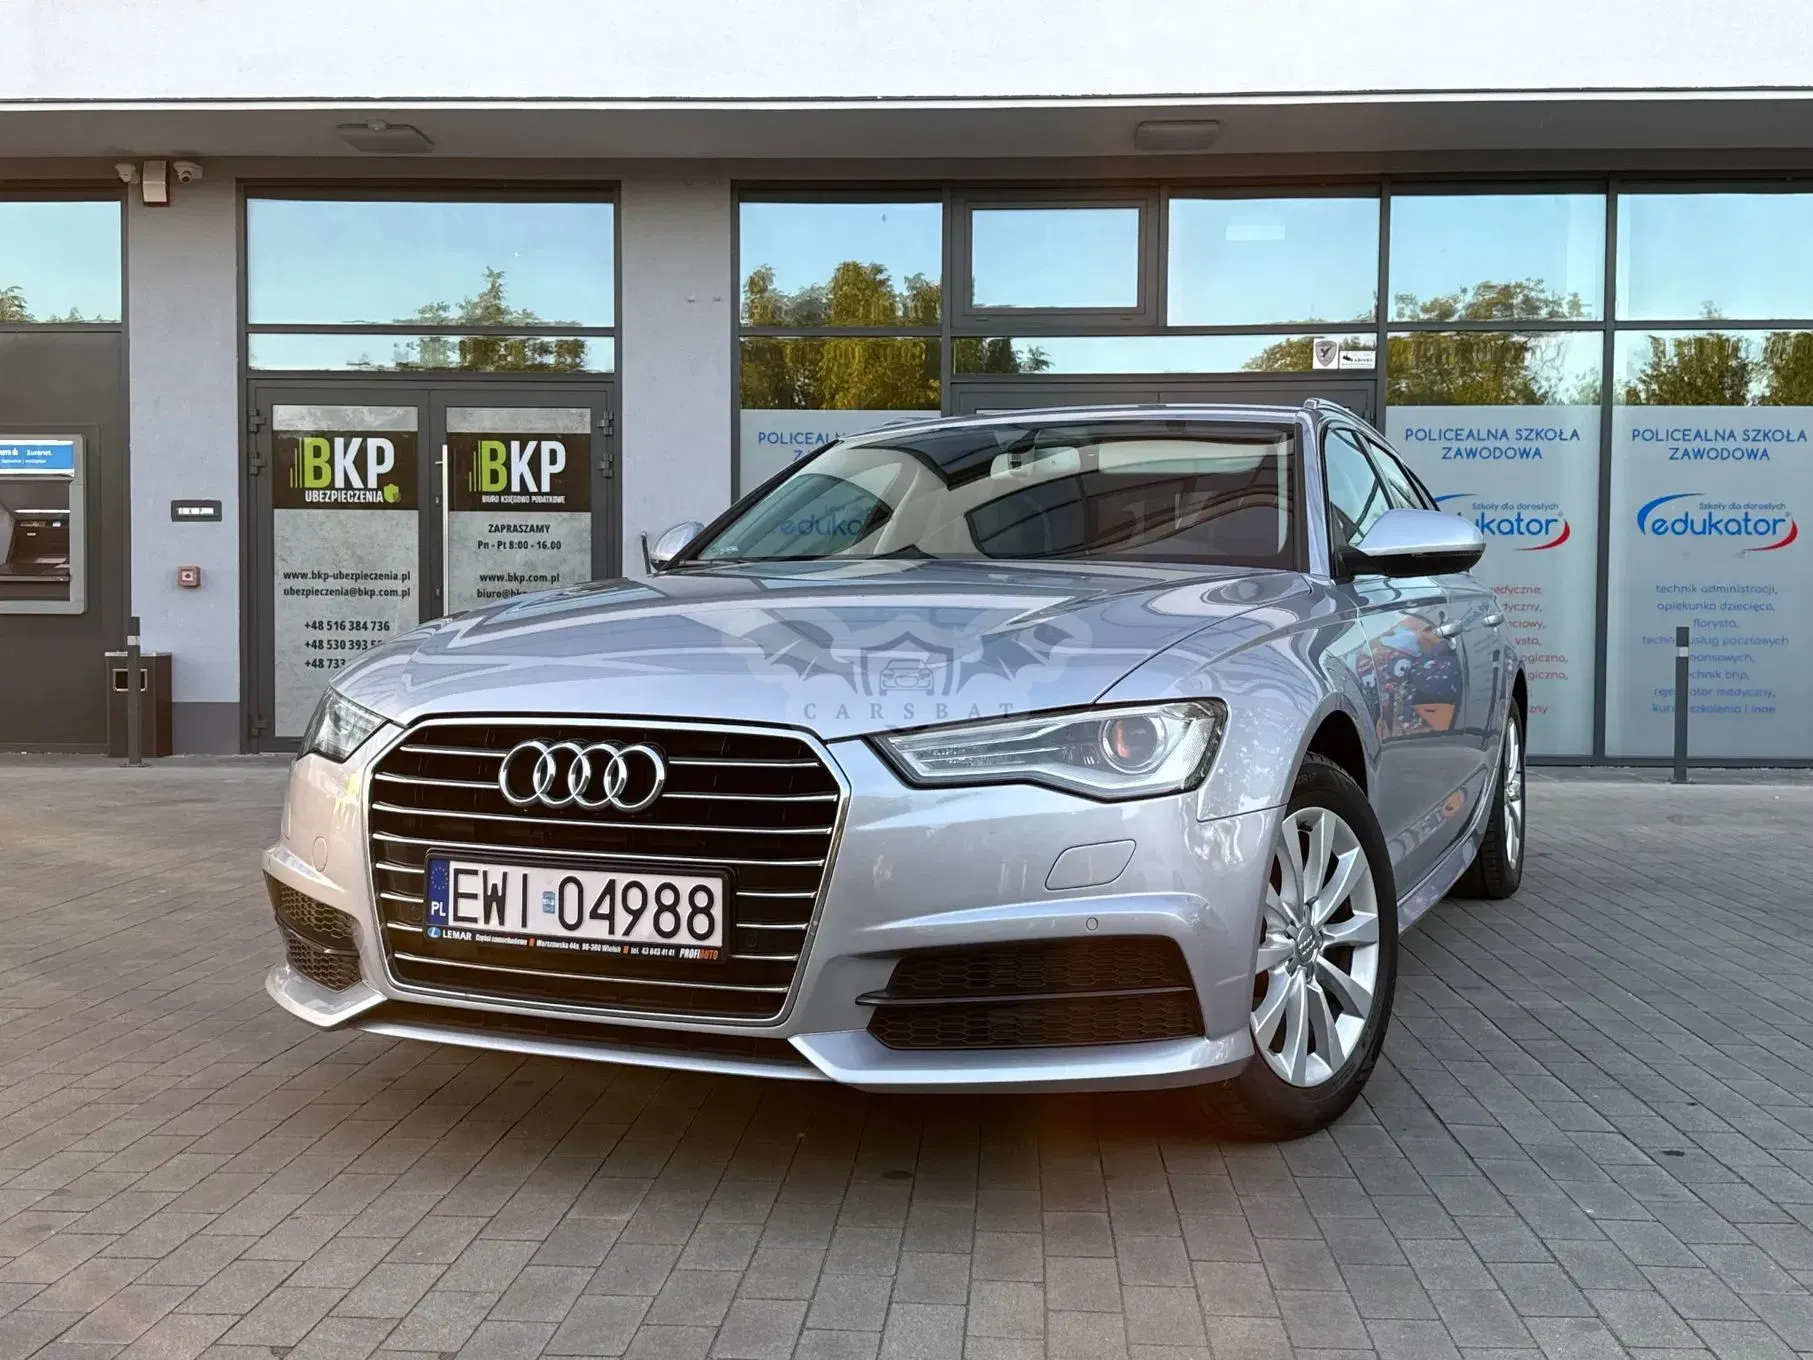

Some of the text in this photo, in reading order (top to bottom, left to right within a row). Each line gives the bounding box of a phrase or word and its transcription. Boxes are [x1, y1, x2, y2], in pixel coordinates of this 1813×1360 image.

[1405, 428, 1581, 442] POLICEALNA SZKOŁA
[1631, 428, 1808, 442] POLICEALNA SZKOŁA
[1442, 446, 1543, 460] ZAWODOWA
[1668, 447, 1770, 461] ZAWODOWA
[303, 437, 395, 489] BKP
[481, 440, 566, 492] BKP
[305, 489, 383, 503] UBEZPIECZENIA
[482, 494, 499, 503] BIURO
[531, 495, 566, 504] PODATKOWE
[488, 524, 551, 534] ZAPRASZAMY
[1651, 511, 1786, 536] edukator
[477, 540, 489, 550] Pn
[497, 540, 507, 550] Pt
[509, 540, 529, 550] 8:00
[283, 570, 410, 583] www.bkp-ubezpieczenia.pl
[480, 572, 560, 584] www.bkp.com.pl
[283, 586, 410, 599] ubezpieczenia@bkp.com.pl
[1656, 584, 1697, 594] technik
[305, 620, 390, 631] +48 516 384 736
[305, 639, 324, 650] +48
[327, 639, 346, 650] 530
[348, 639, 368, 650] 393
[1642, 636, 1674, 645] techn
[305, 658, 324, 669] +48
[431, 867, 715, 941] PL EWI 04988
[443, 929, 472, 940] LEMAR
